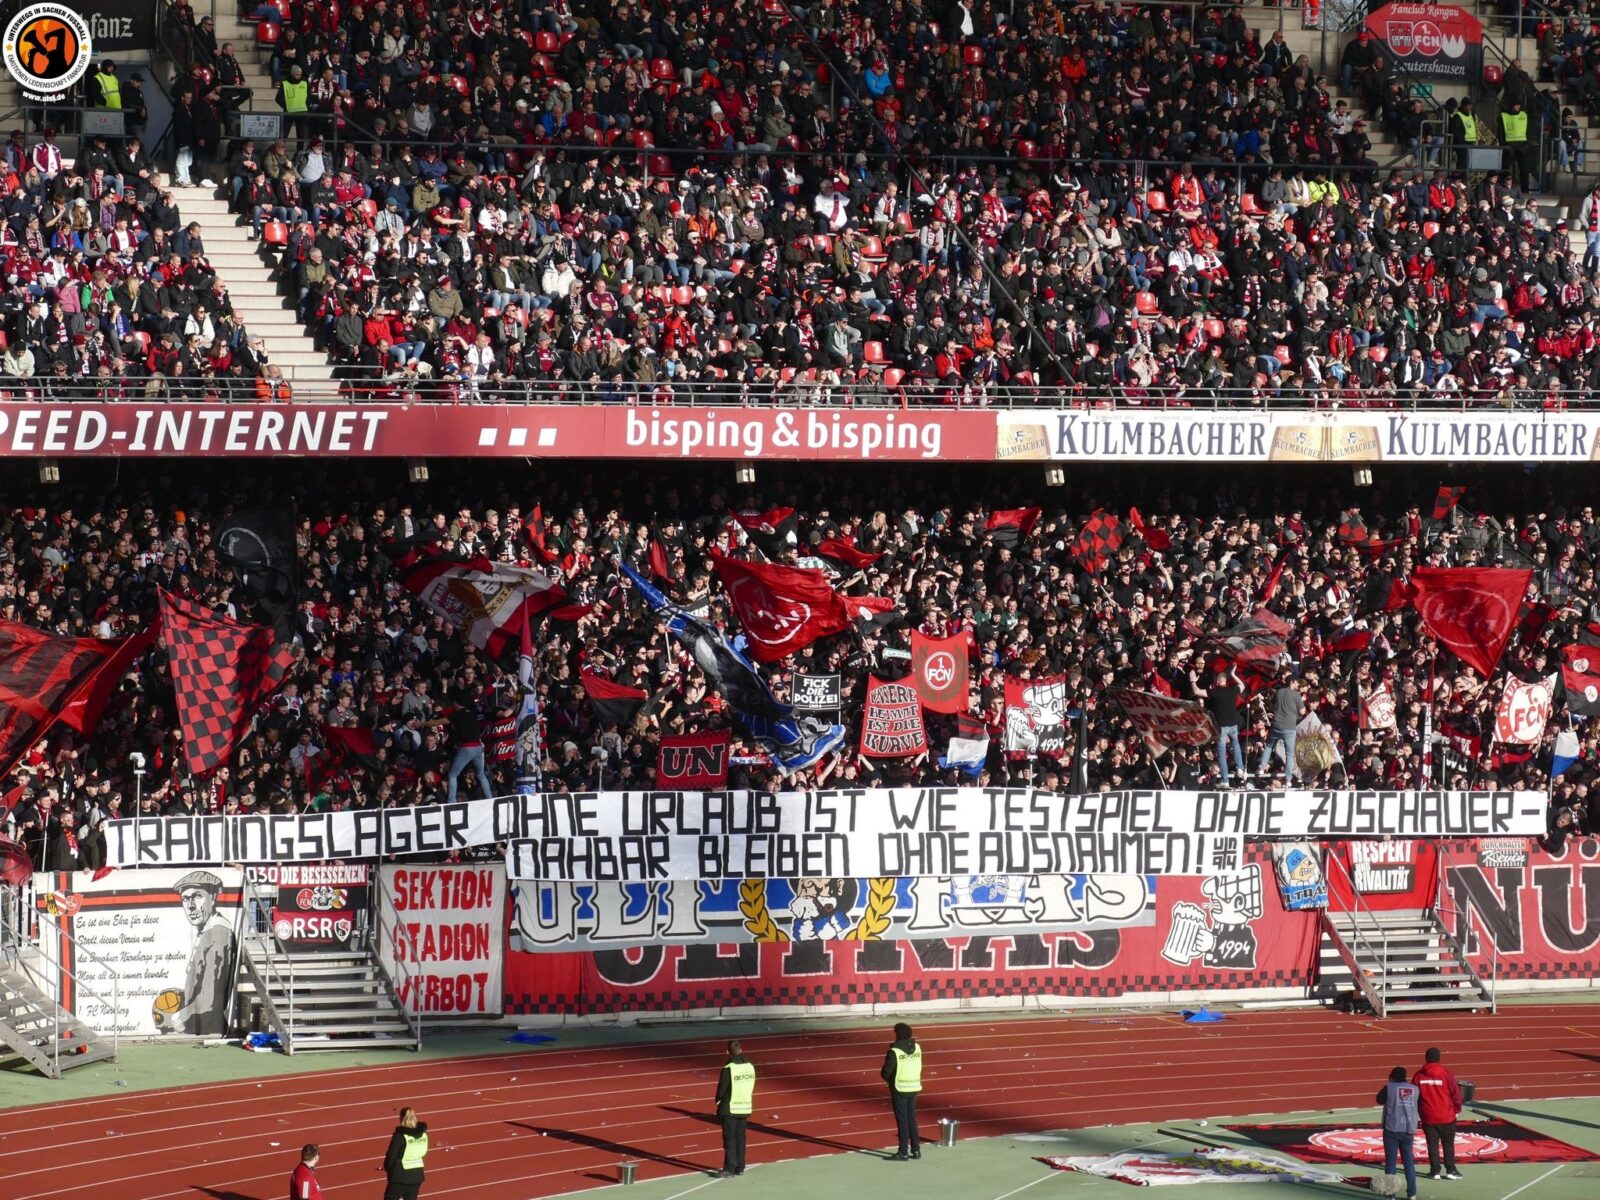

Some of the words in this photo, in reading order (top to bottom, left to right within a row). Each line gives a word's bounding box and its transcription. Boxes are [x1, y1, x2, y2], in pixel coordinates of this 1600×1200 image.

[1391, 3, 1425, 15] Fanclub
[1427, 5, 1459, 19] Rangau
[1414, 35, 1440, 47] FCN
[627, 410, 764, 457] bisping
[772, 412, 800, 448] &
[808, 413, 942, 458] bisping
[1056, 414, 1266, 456] KULMBACHER
[1387, 416, 1587, 456] KULMBACHER
[803, 678, 830, 688] FICK
[928, 668, 951, 681] FCN
[794, 693, 838, 704] POLIZEI
[866, 719, 890, 732] IST
[893, 718, 921, 733] DIE
[1514, 702, 1547, 733] FCN
[864, 731, 924, 754] KURVE
[1040, 738, 1064, 751] 1994
[661, 745, 725, 778] UN
[107, 802, 469, 864] TRAININGSLAGER
[493, 793, 600, 841] OHNE
[621, 791, 782, 837] URLAUB
[804, 790, 866, 832] IST
[888, 789, 957, 832] WIE
[983, 789, 1174, 833] TESTSPIEL
[1194, 792, 1286, 834] OHNE
[512, 836, 670, 880] NAHBAR
[698, 834, 850, 878] BLEIBEN
[877, 832, 969, 877] OHNE
[1352, 840, 1413, 863] RESPEKT
[281, 866, 299, 884] DIE
[301, 864, 366, 884] BESESSENEN
[1354, 866, 1410, 891] RIVALITÄT
[394, 869, 494, 912] SEKTION
[76, 916, 86, 929] Es
[88, 918, 97, 928] ist
[98, 917, 111, 927] eine
[113, 914, 129, 927] Ehre
[130, 915, 141, 928] für
[143, 915, 160, 924] diese
[293, 917, 333, 939] RSR
[99, 936, 119, 945] diesen
[119, 933, 140, 944] Verein
[142, 933, 155, 943] und
[393, 922, 490, 963] STADION
[77, 953, 87, 963] die
[154, 954, 163, 964] zu
[165, 951, 187, 961] spielen
[1218, 941, 1251, 960] 1994
[77, 970, 95, 981] Möge
[98, 971, 107, 980] all
[99, 988, 112, 997] und
[395, 972, 489, 1013] VERBOT
[86, 1004, 98, 1016] FC
